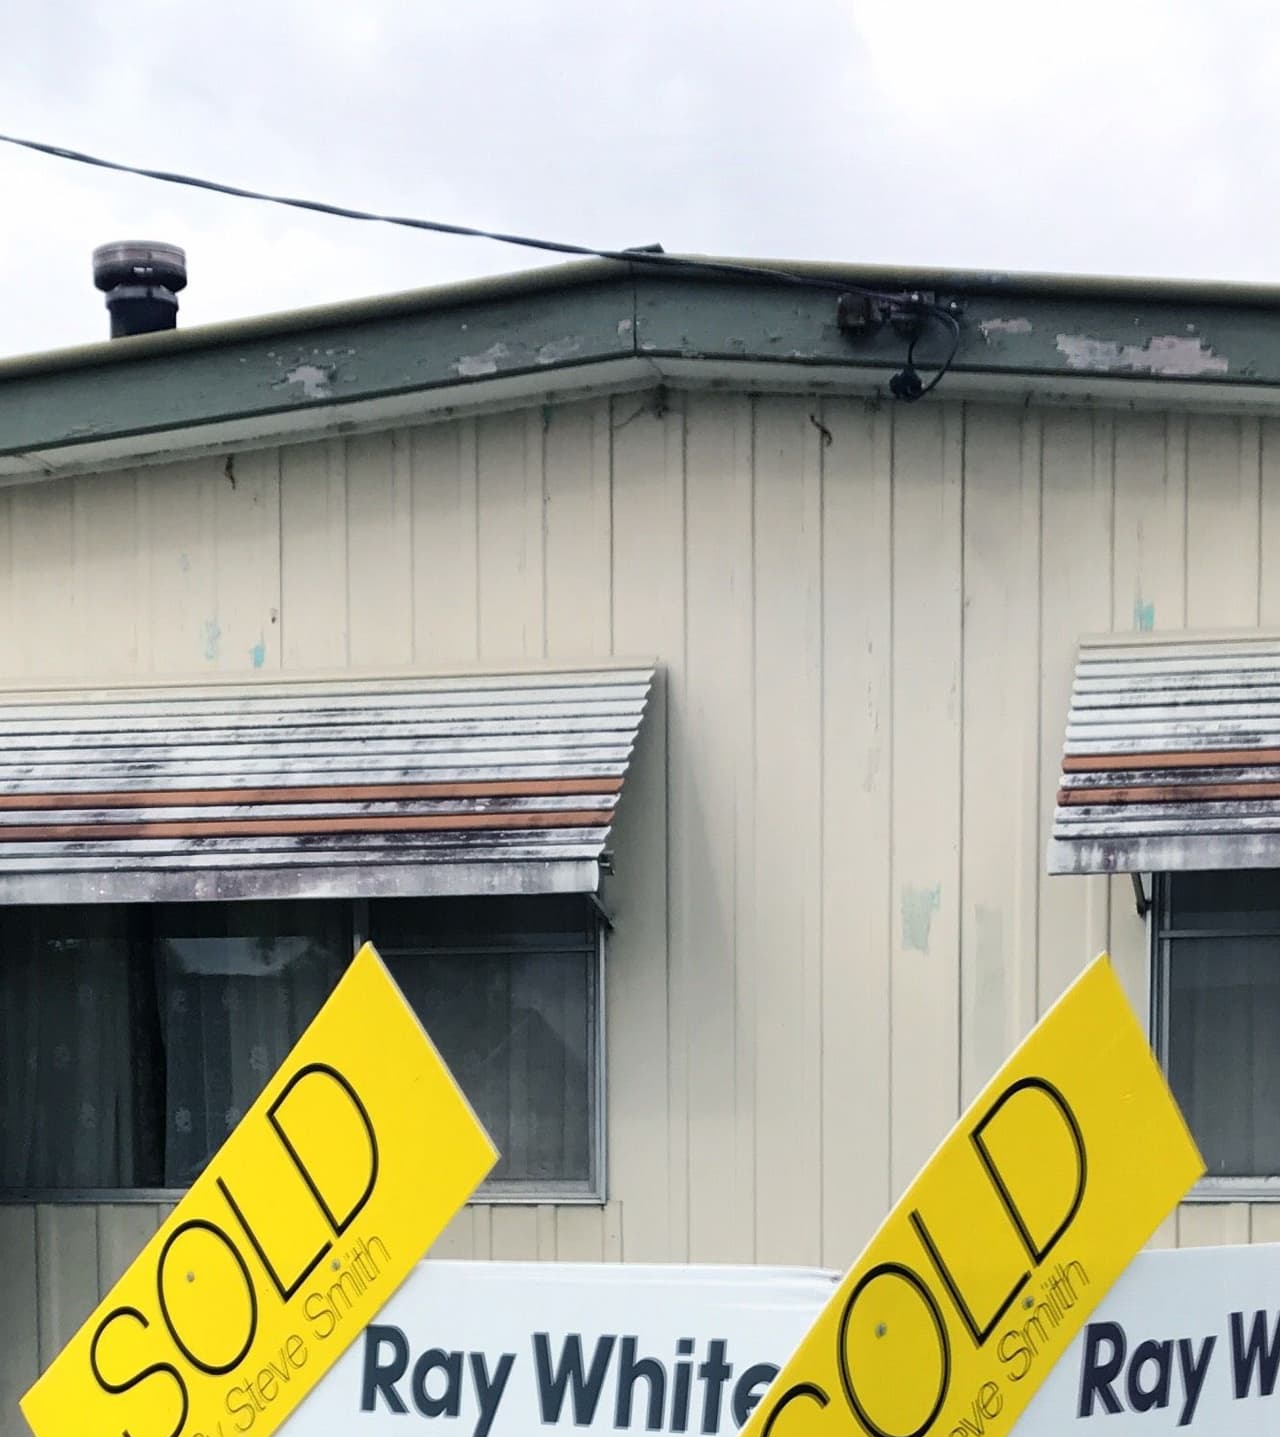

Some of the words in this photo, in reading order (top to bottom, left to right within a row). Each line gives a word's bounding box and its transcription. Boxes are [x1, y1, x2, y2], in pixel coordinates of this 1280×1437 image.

[224, 1335, 309, 1434] Steve
[302, 1232, 392, 1340] Smith
[997, 1257, 1089, 1382] Smith
[1075, 1321, 1217, 1427] Ray
